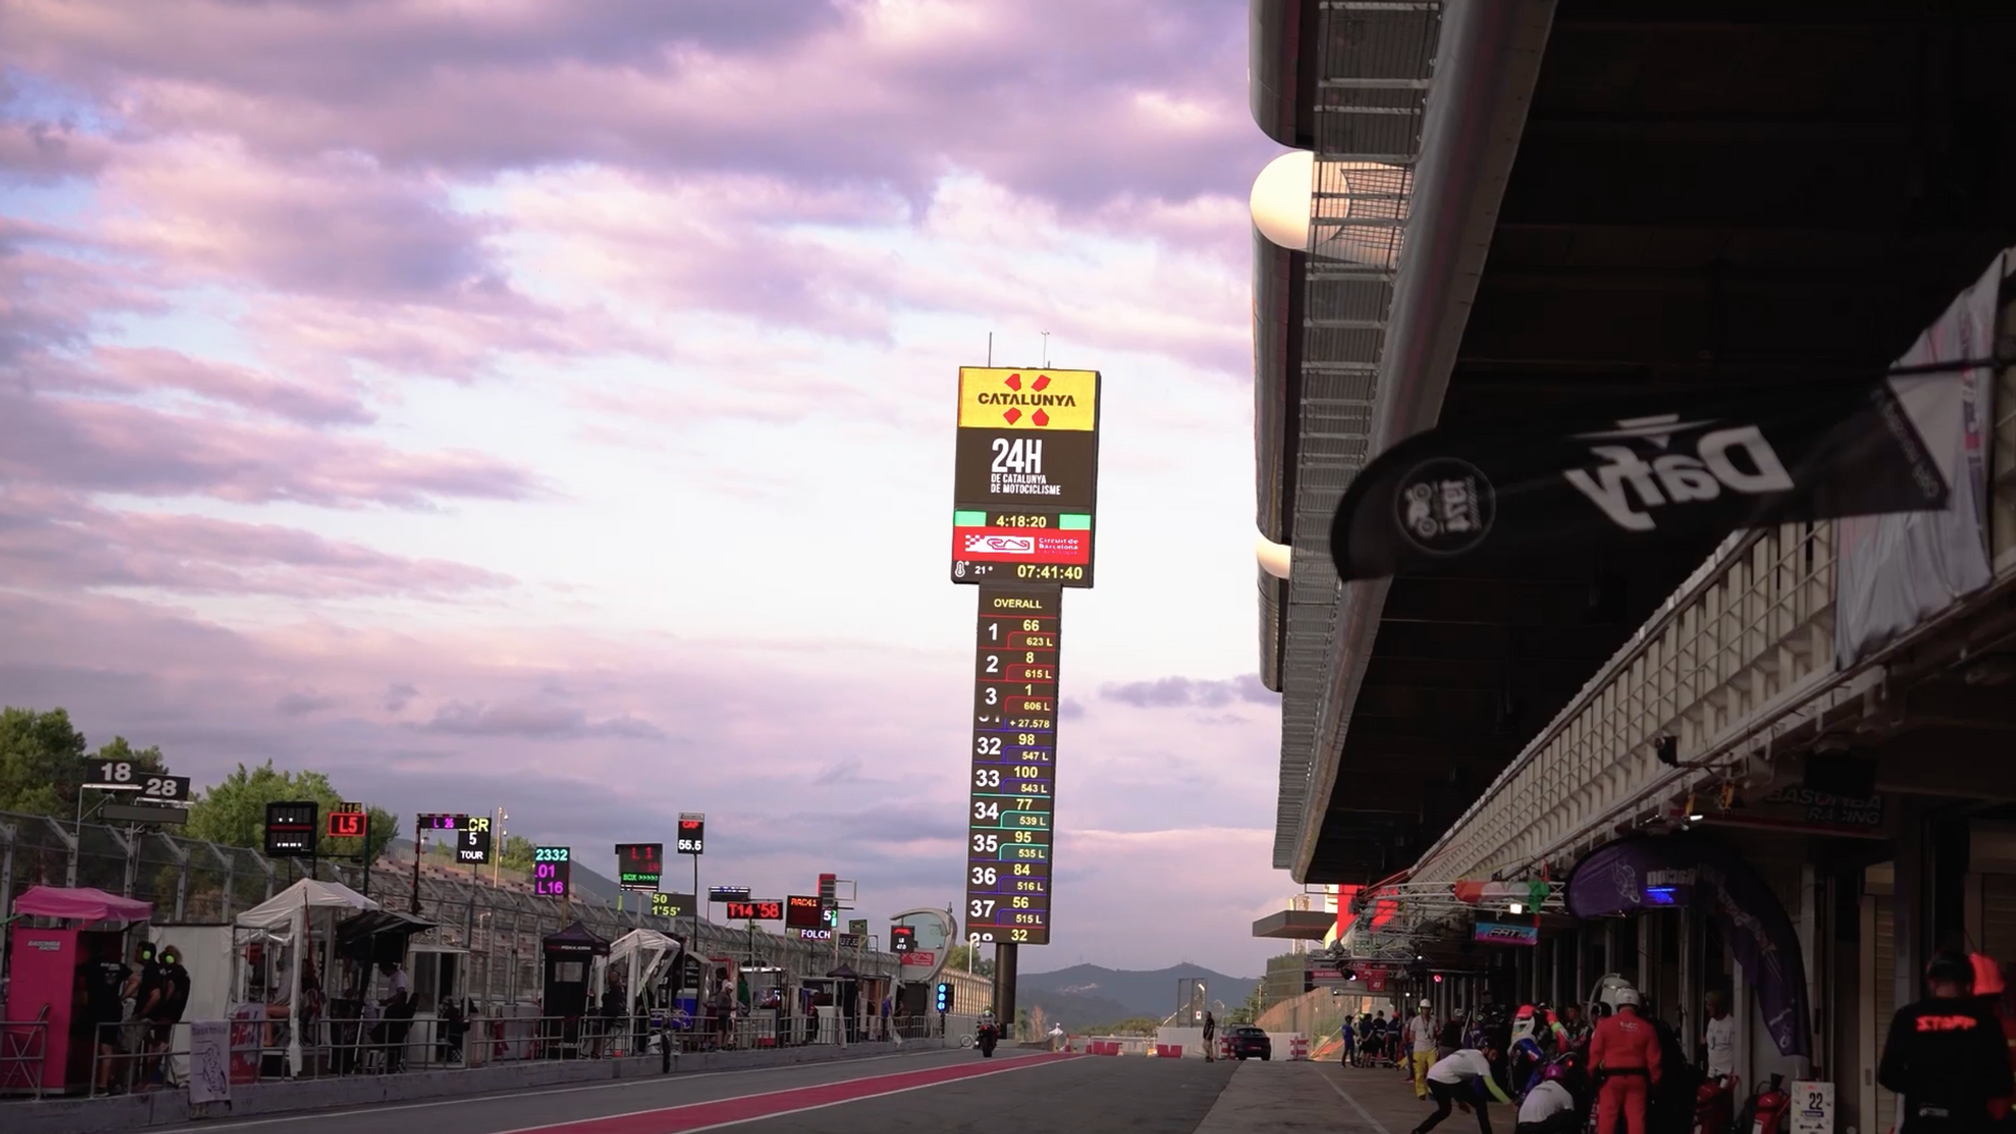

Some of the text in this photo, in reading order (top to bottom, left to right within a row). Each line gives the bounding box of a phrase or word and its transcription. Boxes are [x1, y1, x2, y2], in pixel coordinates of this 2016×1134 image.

[978, 393, 1076, 407] CATALUNYA
[991, 438, 1042, 473] 24H
[991, 473, 1047, 484] DE CATALUNYA
[991, 484, 1061, 495] DE MOTOCICLISME
[996, 515, 1047, 528] 4:18:20
[1017, 565, 1083, 580] 07:41:40
[994, 598, 1042, 609] OVERALL
[988, 623, 998, 641] 1
[1023, 619, 1040, 632] 66
[1026, 637, 1053, 647] 623 L
[986, 655, 999, 673] 2
[1026, 652, 1034, 664] 8
[1025, 669, 1052, 679] 615 L
[985, 687, 998, 705] 3
[1025, 684, 1032, 696] 1
[1024, 701, 1051, 711] 606 L
[1018, 719, 1050, 729] 27.578
[977, 736, 1001, 755] 32
[1018, 733, 1035, 746] 98
[1022, 751, 1049, 761] 547 L
[101, 762, 131, 781] 18
[1014, 766, 1038, 779] 100
[975, 769, 1000, 788] 33
[145, 778, 177, 796] 28
[1021, 783, 1047, 793] 543 L
[341, 803, 361, 813] 115
[974, 801, 999, 820] 34
[1016, 798, 1033, 811] 77
[340, 817, 358, 833] L5
[1019, 816, 1046, 826] 539 L
[469, 832, 477, 845] 5
[973, 834, 998, 853] 35
[1015, 831, 1032, 843] 95
[460, 850, 484, 860] TOUR
[535, 849, 568, 861] 2332
[631, 846, 653, 860] L 1
[1018, 849, 1045, 859] 535 L
[971, 866, 996, 885] 36
[1013, 864, 1030, 876] 84
[538, 881, 564, 894] L16
[1017, 881, 1043, 891] 516 L
[652, 893, 668, 904] 50
[1012, 896, 1029, 909] 56
[729, 902, 754, 918] T14
[970, 899, 995, 917] 37
[823, 910, 832, 921] 5
[1015, 914, 1042, 924] 515 L
[801, 929, 831, 939] FOLCH
[1011, 929, 1028, 942] 32
[1809, 1092, 1823, 1110] 22
